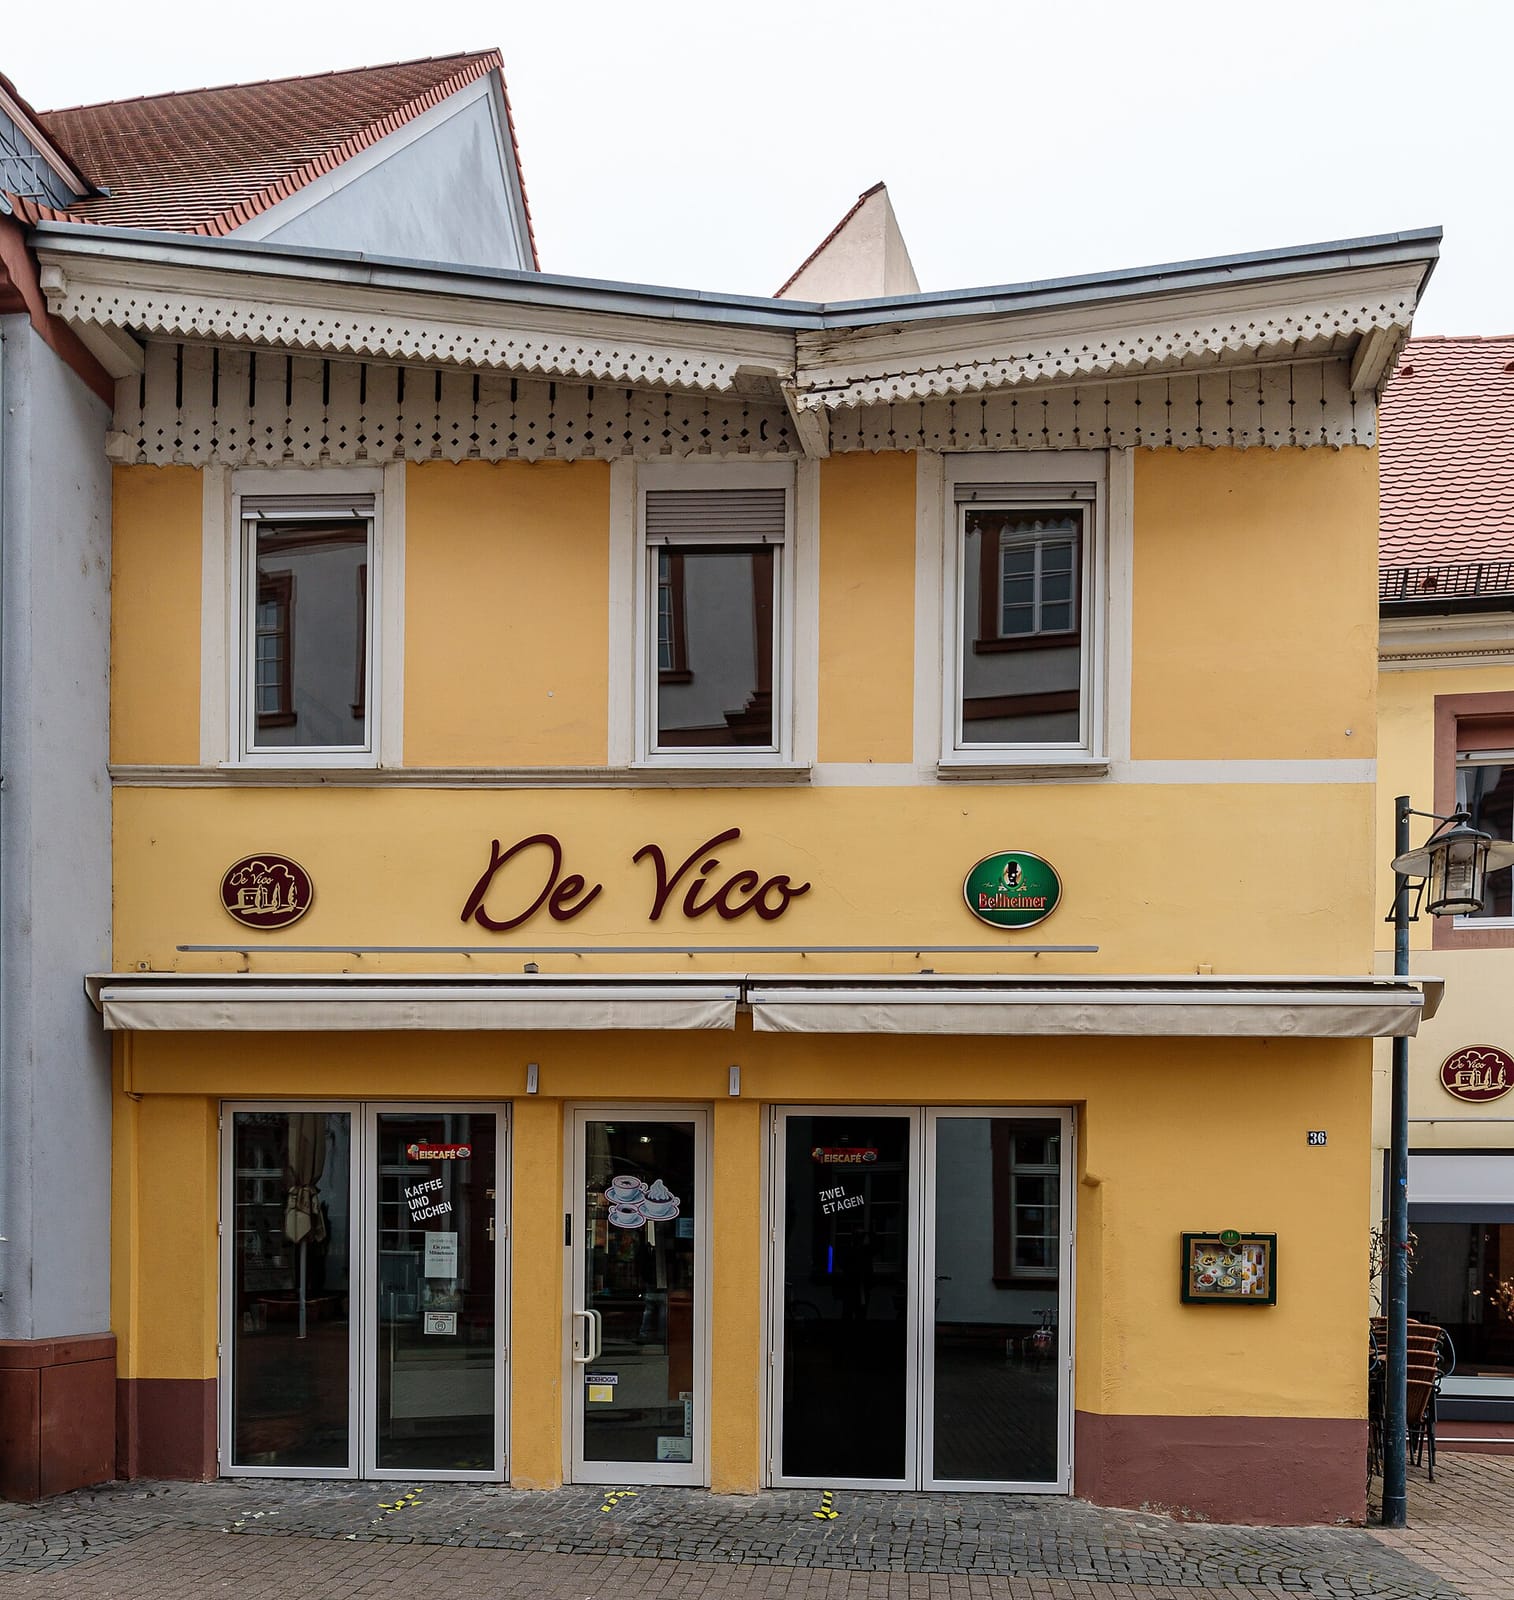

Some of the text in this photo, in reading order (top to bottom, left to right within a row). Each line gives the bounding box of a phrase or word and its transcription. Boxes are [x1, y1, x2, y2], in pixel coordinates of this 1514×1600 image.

[230, 871, 274, 886] De Vico
[460, 827, 812, 931] De Vico
[979, 893, 1047, 908] Bellheimer
[1309, 1132, 1325, 1145] 36
[419, 1148, 456, 1160] EISCAFÉ
[824, 1152, 862, 1163] EISCAFÉ
[404, 1179, 443, 1198] KAFFEE
[819, 1186, 845, 1201] ZWEI
[408, 1196, 430, 1210] UND
[823, 1195, 864, 1214] ETAGEN
[411, 1200, 453, 1222] KUCHEN
